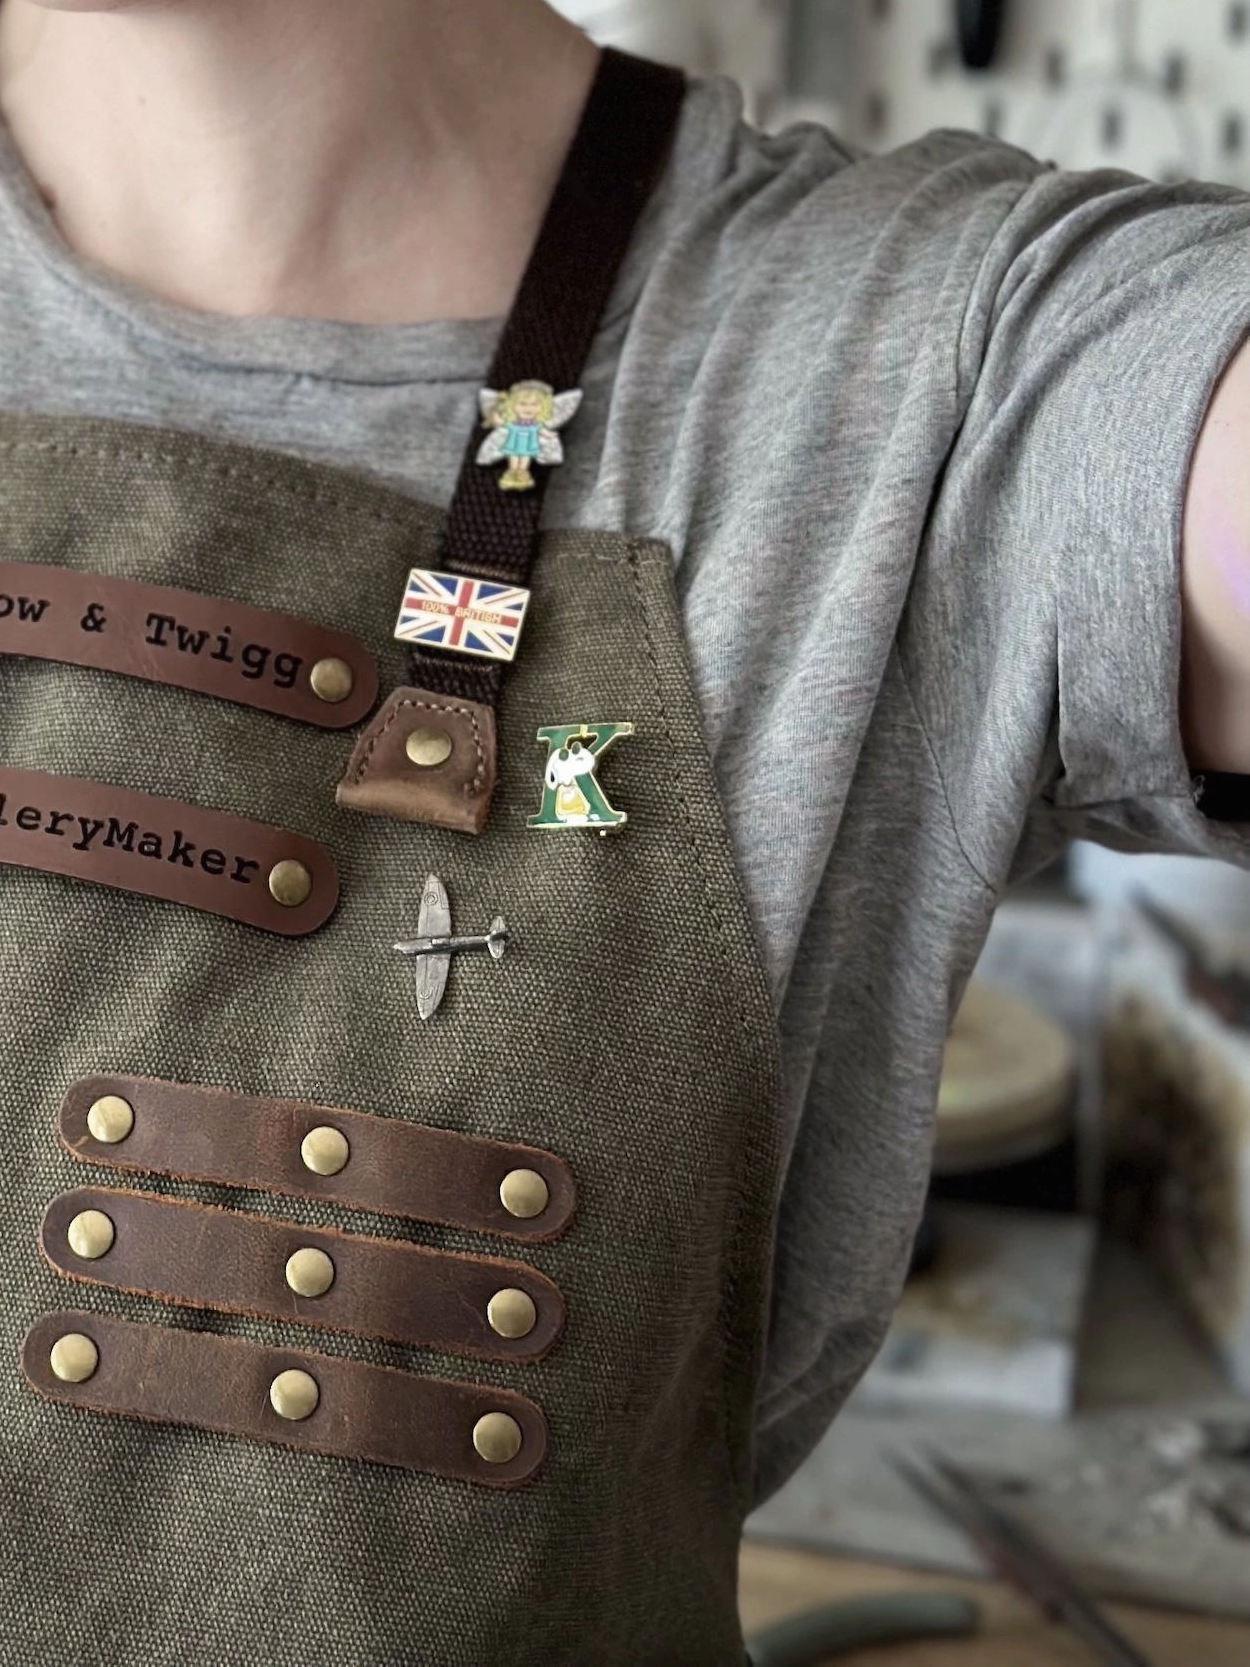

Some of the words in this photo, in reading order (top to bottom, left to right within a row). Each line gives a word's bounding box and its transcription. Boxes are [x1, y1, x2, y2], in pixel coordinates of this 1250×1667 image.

[421, 600, 450, 615] 100%
[454, 605, 502, 624] BRITISH
[80, 602, 107, 634] &
[146, 611, 305, 687] Twigg
